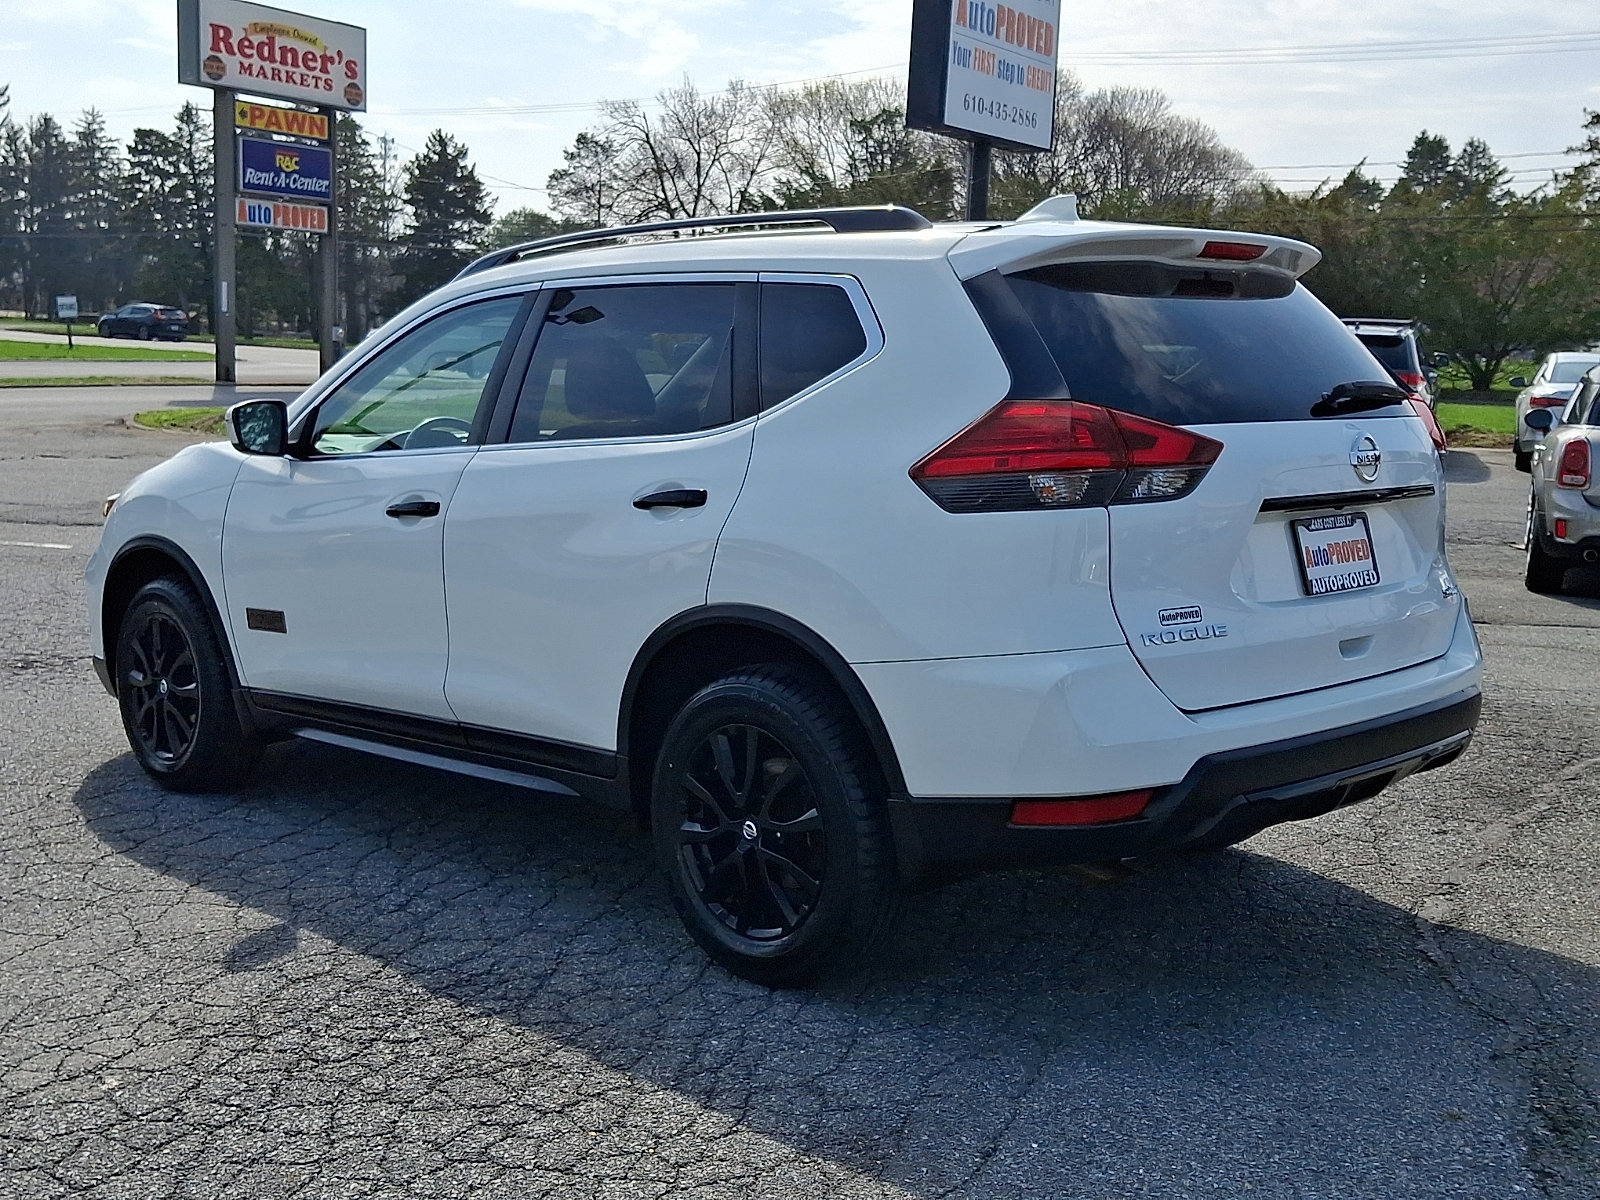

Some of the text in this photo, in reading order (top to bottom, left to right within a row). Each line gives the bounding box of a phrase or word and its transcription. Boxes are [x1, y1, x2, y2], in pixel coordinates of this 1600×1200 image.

[956, 0, 1054, 56] AutoPROVED
[209, 23, 358, 80] Redner's
[953, 40, 1052, 93] Your FIRST step to CREDIT
[238, 61, 334, 92] MARKETS
[248, 105, 327, 138] PAWN
[963, 93, 1038, 129] 610-435-2886
[238, 200, 326, 230] AutoPROVED
[1335, 515, 1346, 527] LESS
[1304, 539, 1370, 569] AutoPROVED
[1312, 570, 1378, 595] AUTOPROVED
[1161, 609, 1200, 622] AutoPROVED
[1141, 624, 1228, 648] ROGUE
